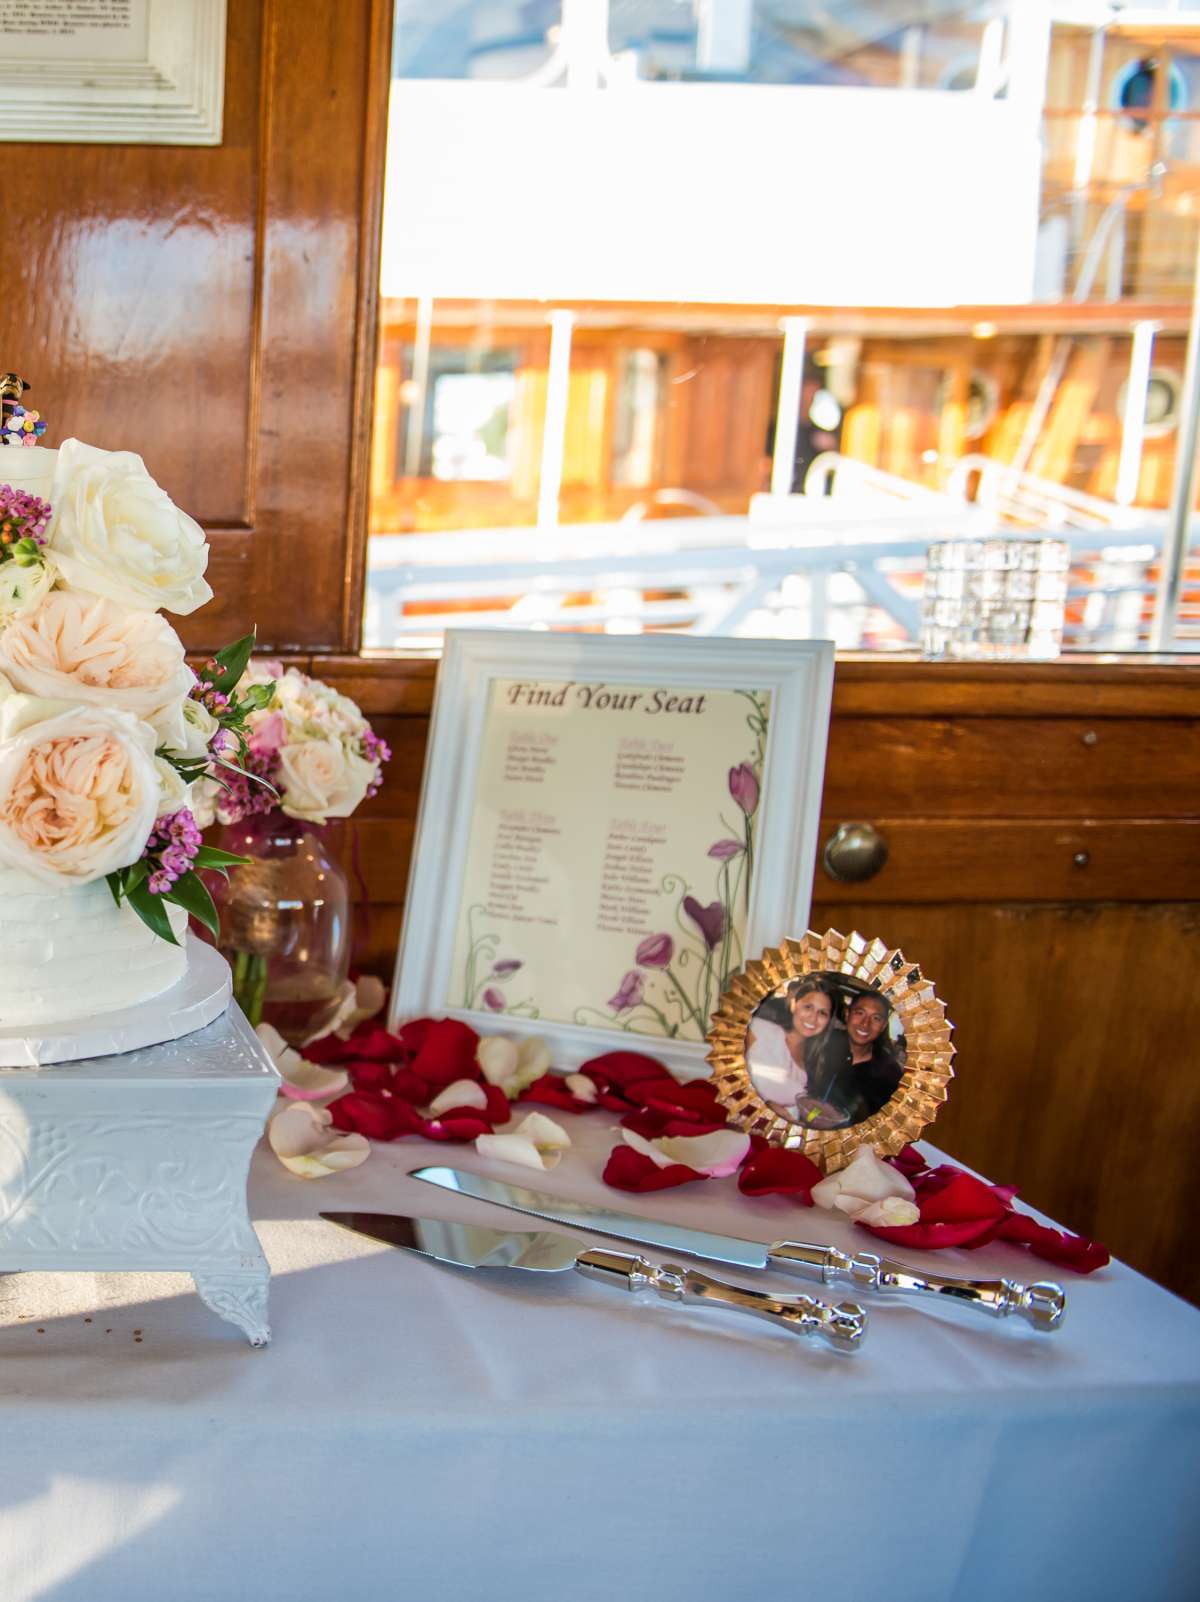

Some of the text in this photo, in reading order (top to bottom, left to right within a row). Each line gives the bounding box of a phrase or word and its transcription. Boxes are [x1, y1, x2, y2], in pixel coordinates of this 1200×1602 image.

[507, 681, 705, 714] Find Your Seat
